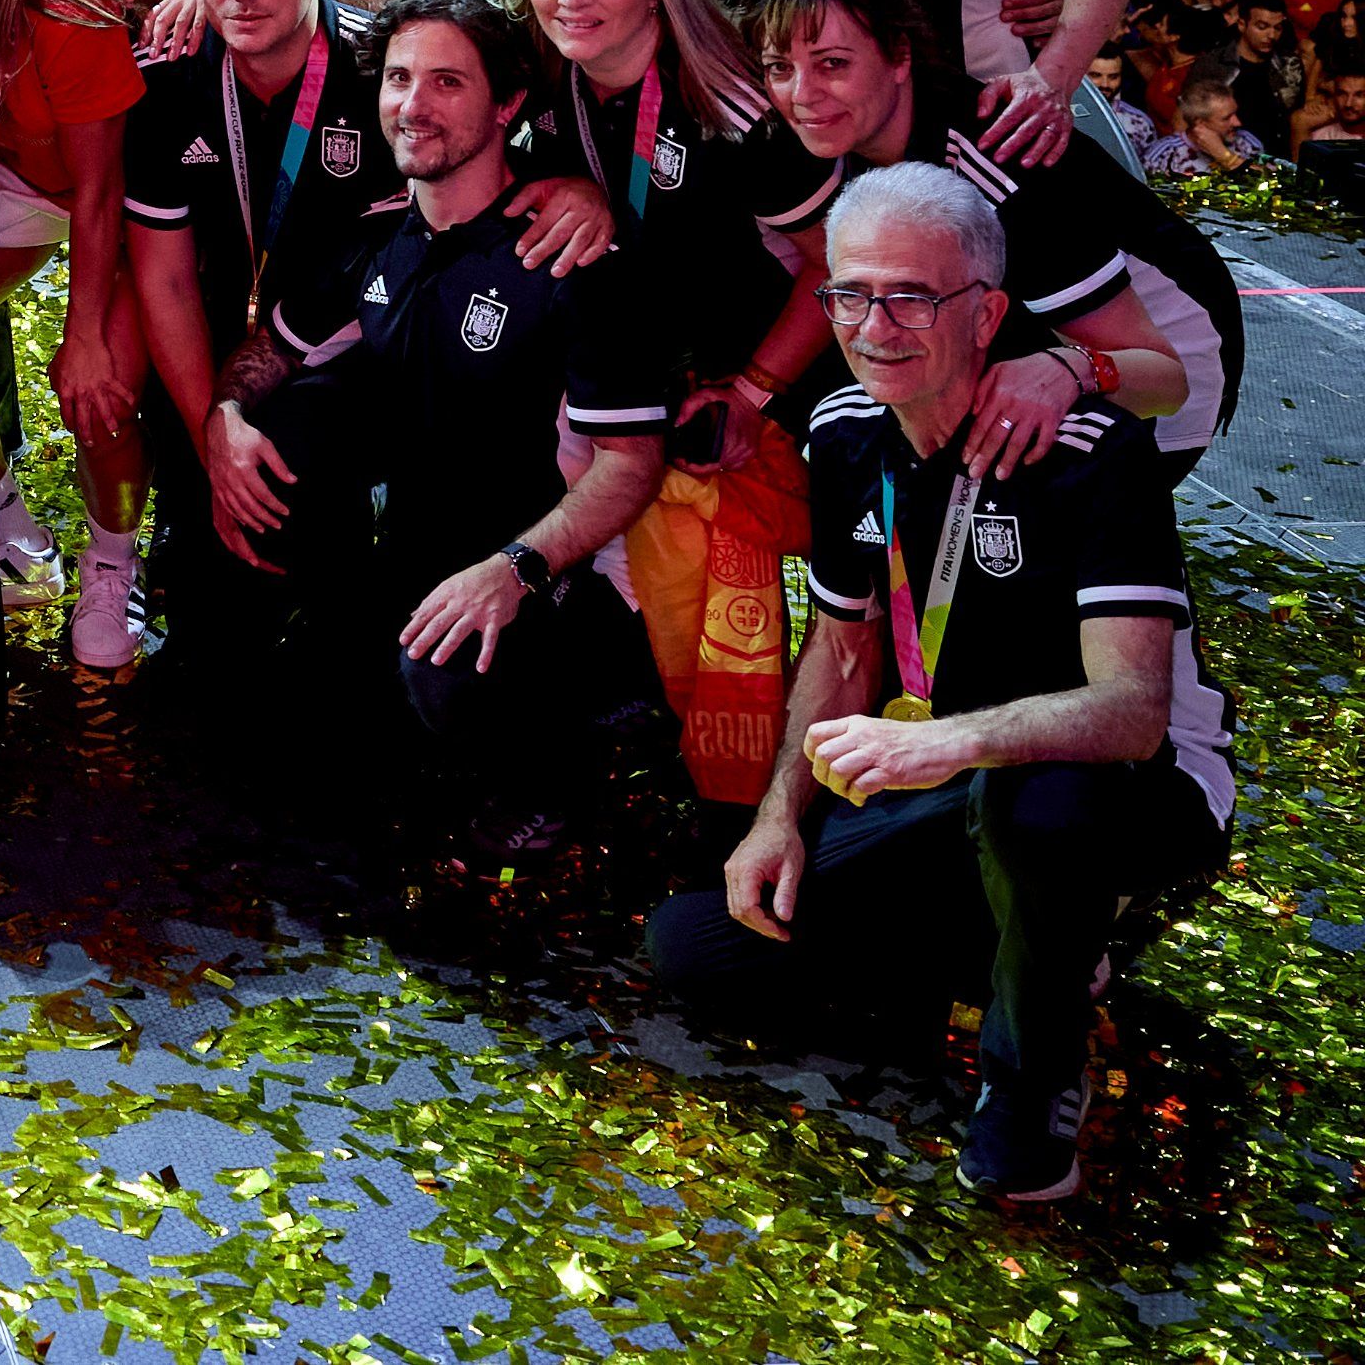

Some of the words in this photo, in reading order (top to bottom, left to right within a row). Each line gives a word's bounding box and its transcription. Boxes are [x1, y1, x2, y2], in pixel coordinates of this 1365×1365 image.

[228, 83, 236, 117] WORLD
[181, 154, 220, 164] adidas
[853, 532, 885, 544] adidas
[946, 507, 964, 560] WOMEN'S
[941, 560, 953, 582] FIFA
